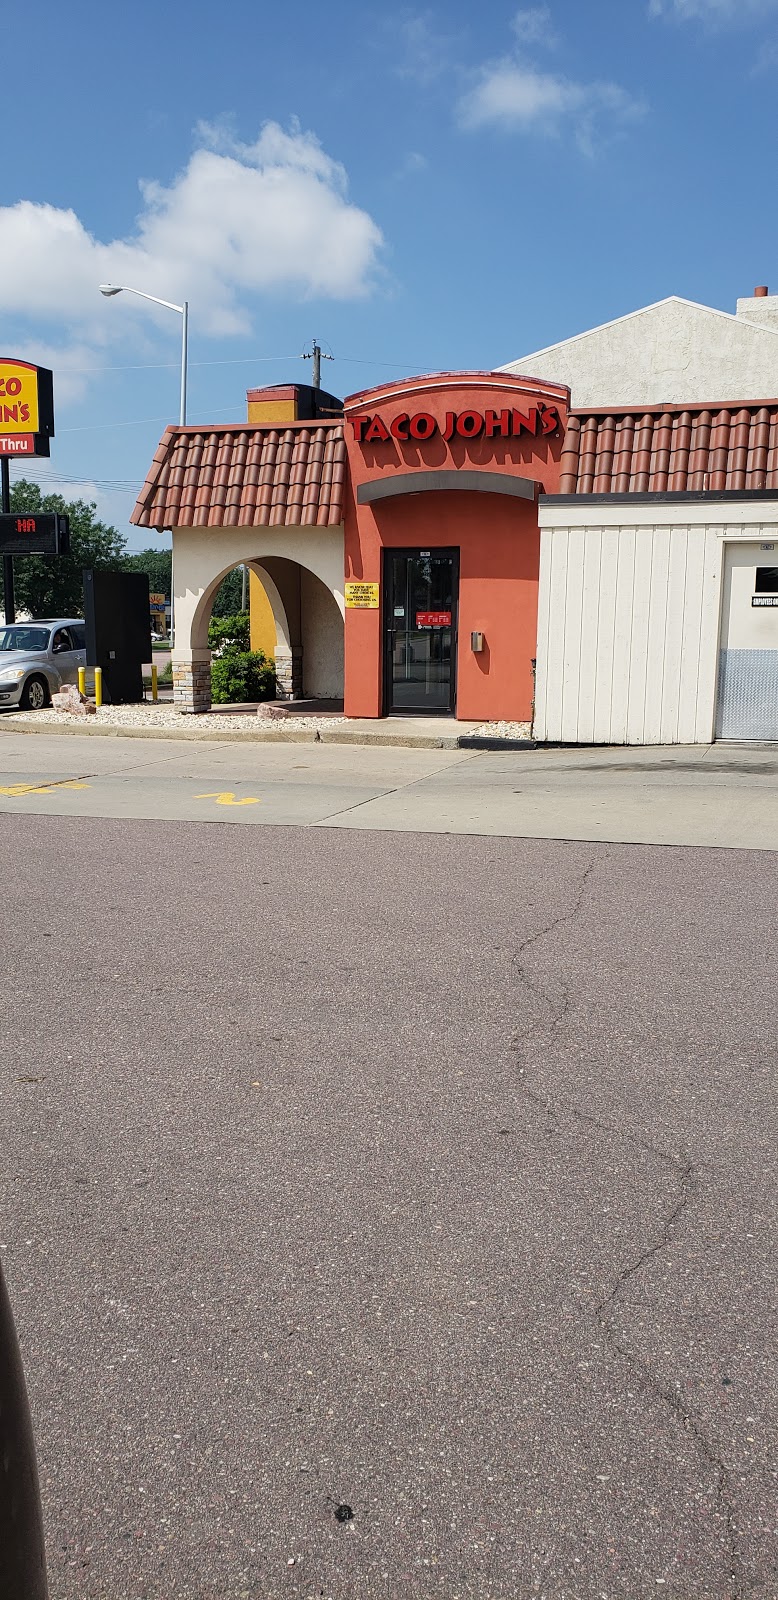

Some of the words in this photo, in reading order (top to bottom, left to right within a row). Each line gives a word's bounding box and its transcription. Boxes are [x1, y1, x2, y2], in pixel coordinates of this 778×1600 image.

[348, 413, 436, 441] TACO
[442, 402, 558, 442] JOHN'S
[1, 438, 28, 450] Thru
